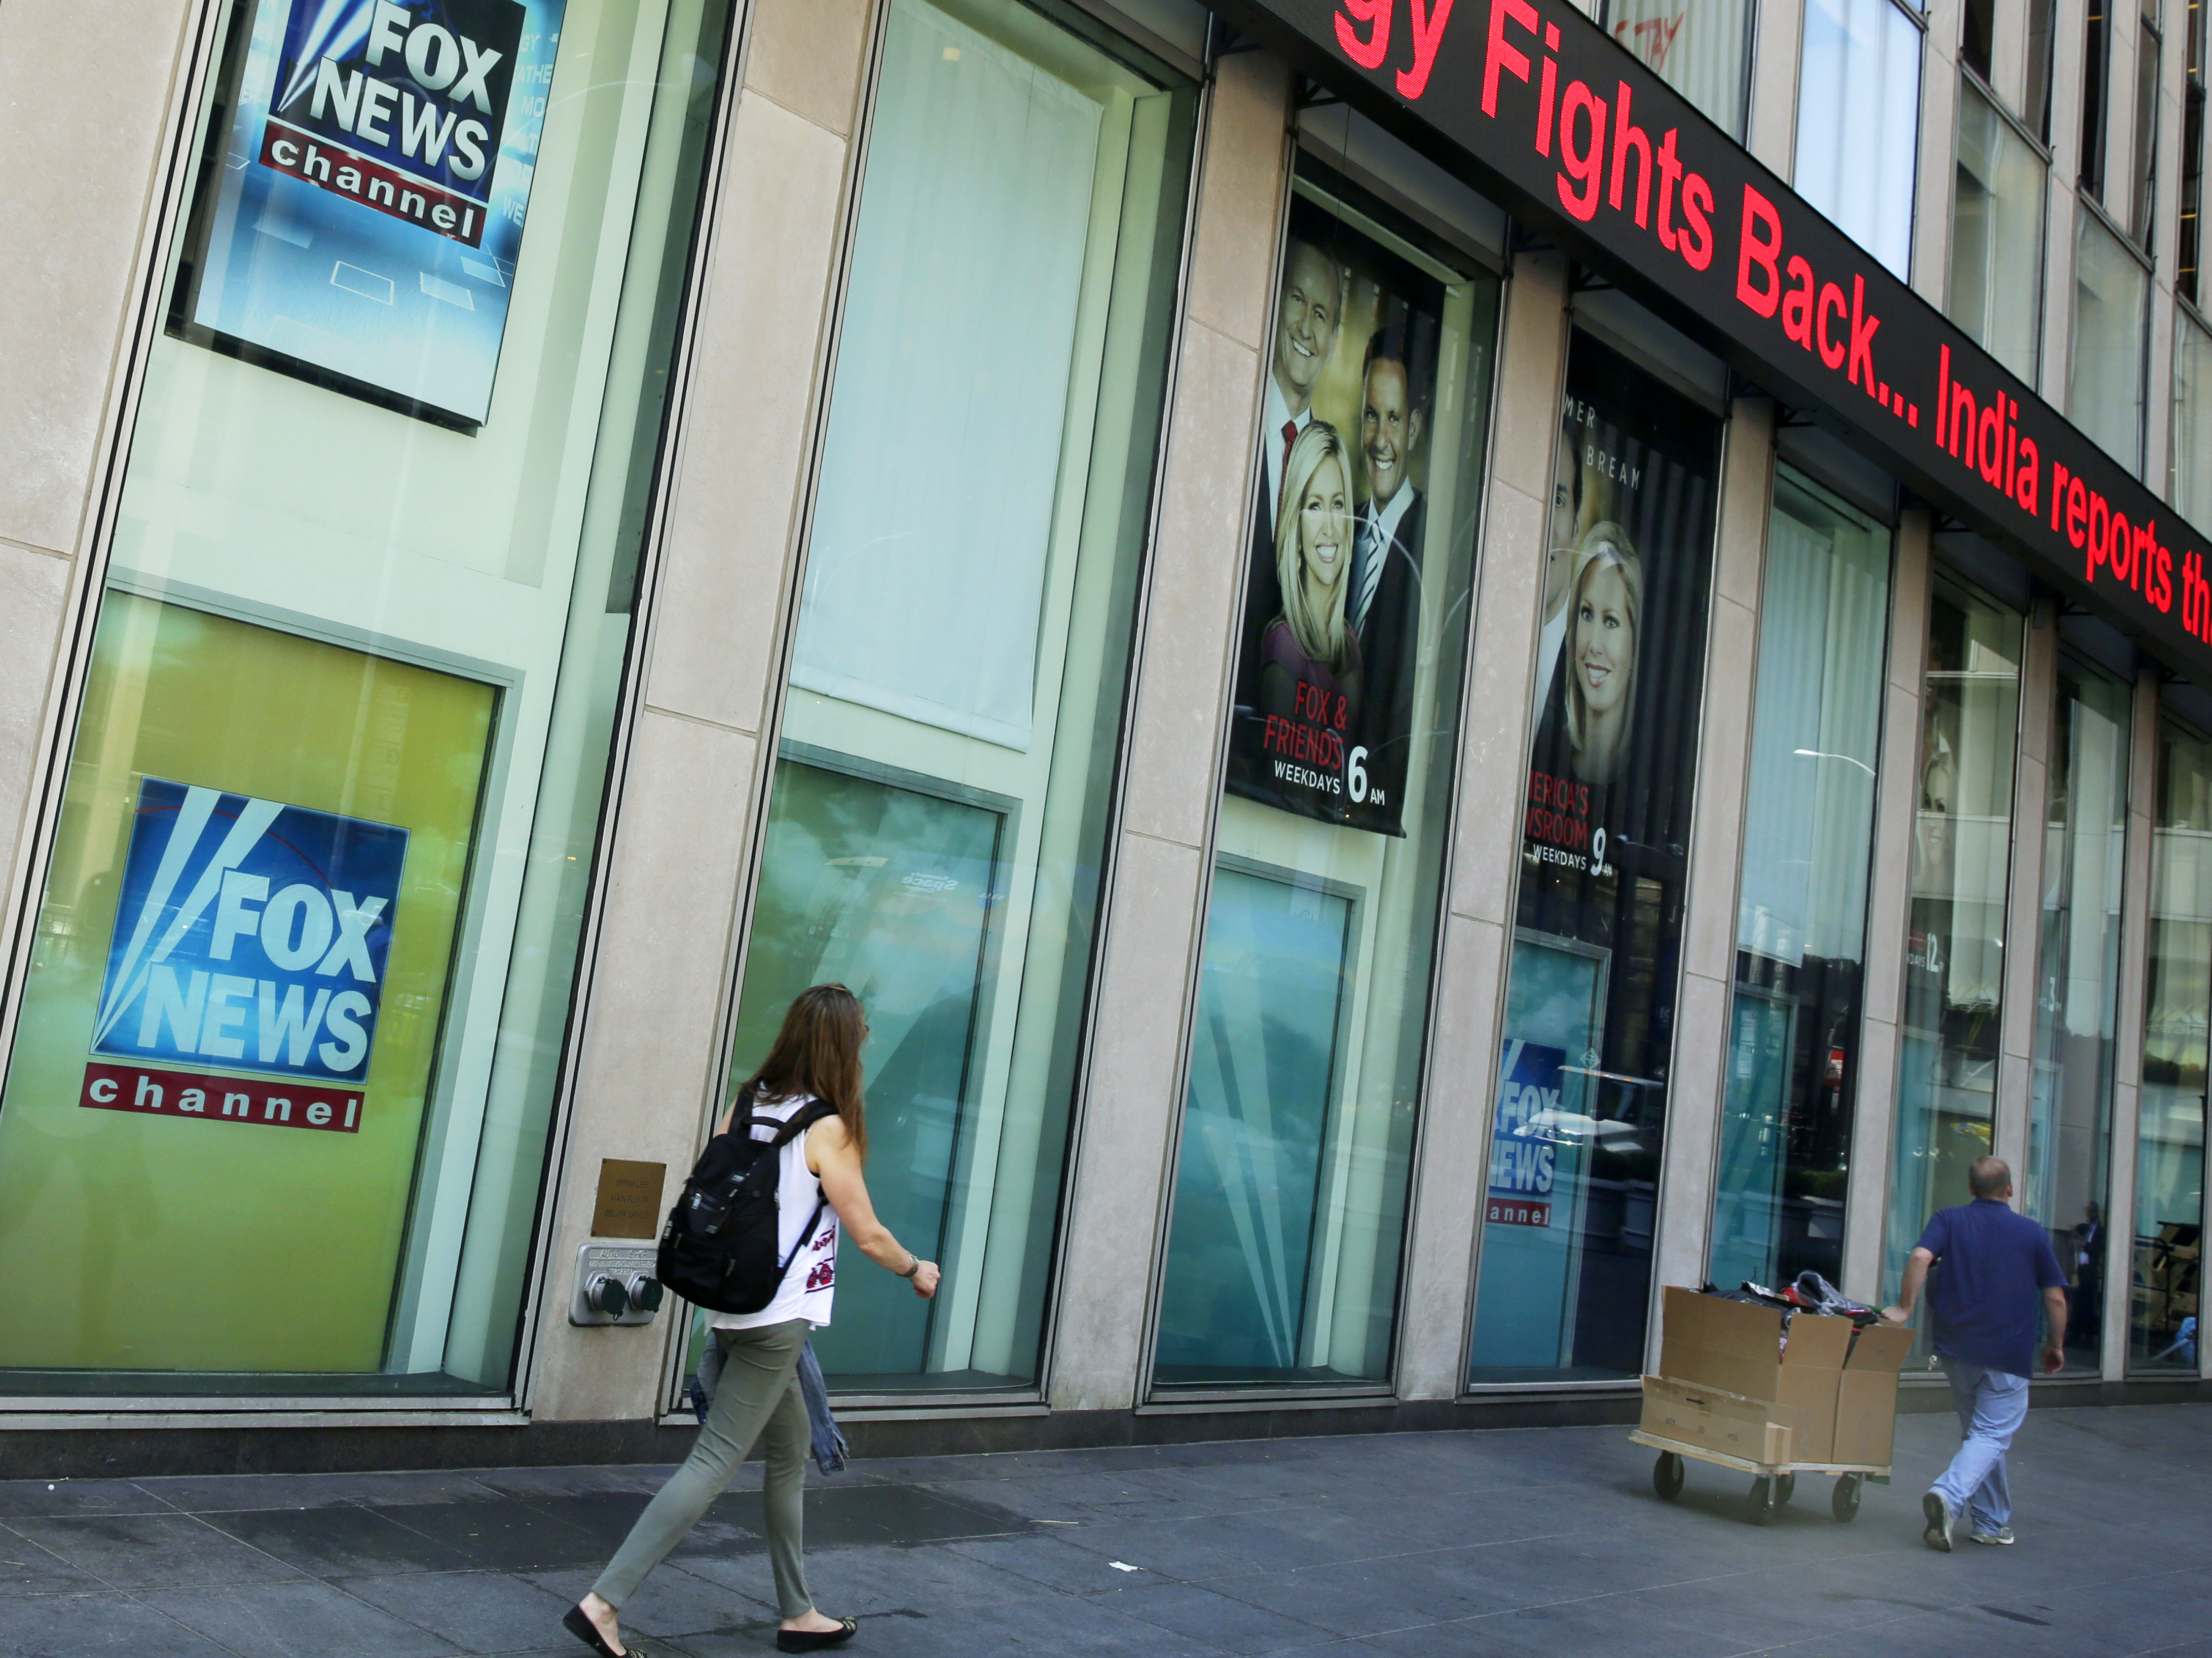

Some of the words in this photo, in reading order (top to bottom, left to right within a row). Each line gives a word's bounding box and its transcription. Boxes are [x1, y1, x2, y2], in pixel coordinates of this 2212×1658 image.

[365, 0, 503, 116] FOX
[310, 56, 489, 180] NEWS
[272, 140, 474, 238] channel
[1334, 0, 1455, 100] gy
[1481, 0, 1714, 271] Fights
[1737, 184, 1918, 428] Back...
[1936, 344, 2039, 516] India
[2051, 462, 2172, 613] reports
[2182, 550, 2212, 649] th
[1587, 444, 1640, 490] BREAM
[1295, 681, 1331, 725] FOX
[1334, 695, 1348, 730] &
[1264, 714, 1345, 770] FRIENDS
[1274, 760, 1341, 794] WEEKDAYS
[1348, 746, 1369, 803] 6
[1370, 788, 1385, 805] AM
[1533, 843, 1587, 870] WEEKDAYS
[1591, 827, 1606, 876] 9
[209, 869, 389, 983] FOX
[137, 965, 372, 1072] NEWS
[90, 1075, 357, 1128] channel
[1500, 1080, 1560, 1139] FOX
[615, 1179, 649, 1188] SPRINKLER
[627, 1195, 648, 1204] FLOOR
[604, 1210, 626, 1218] BELOW
